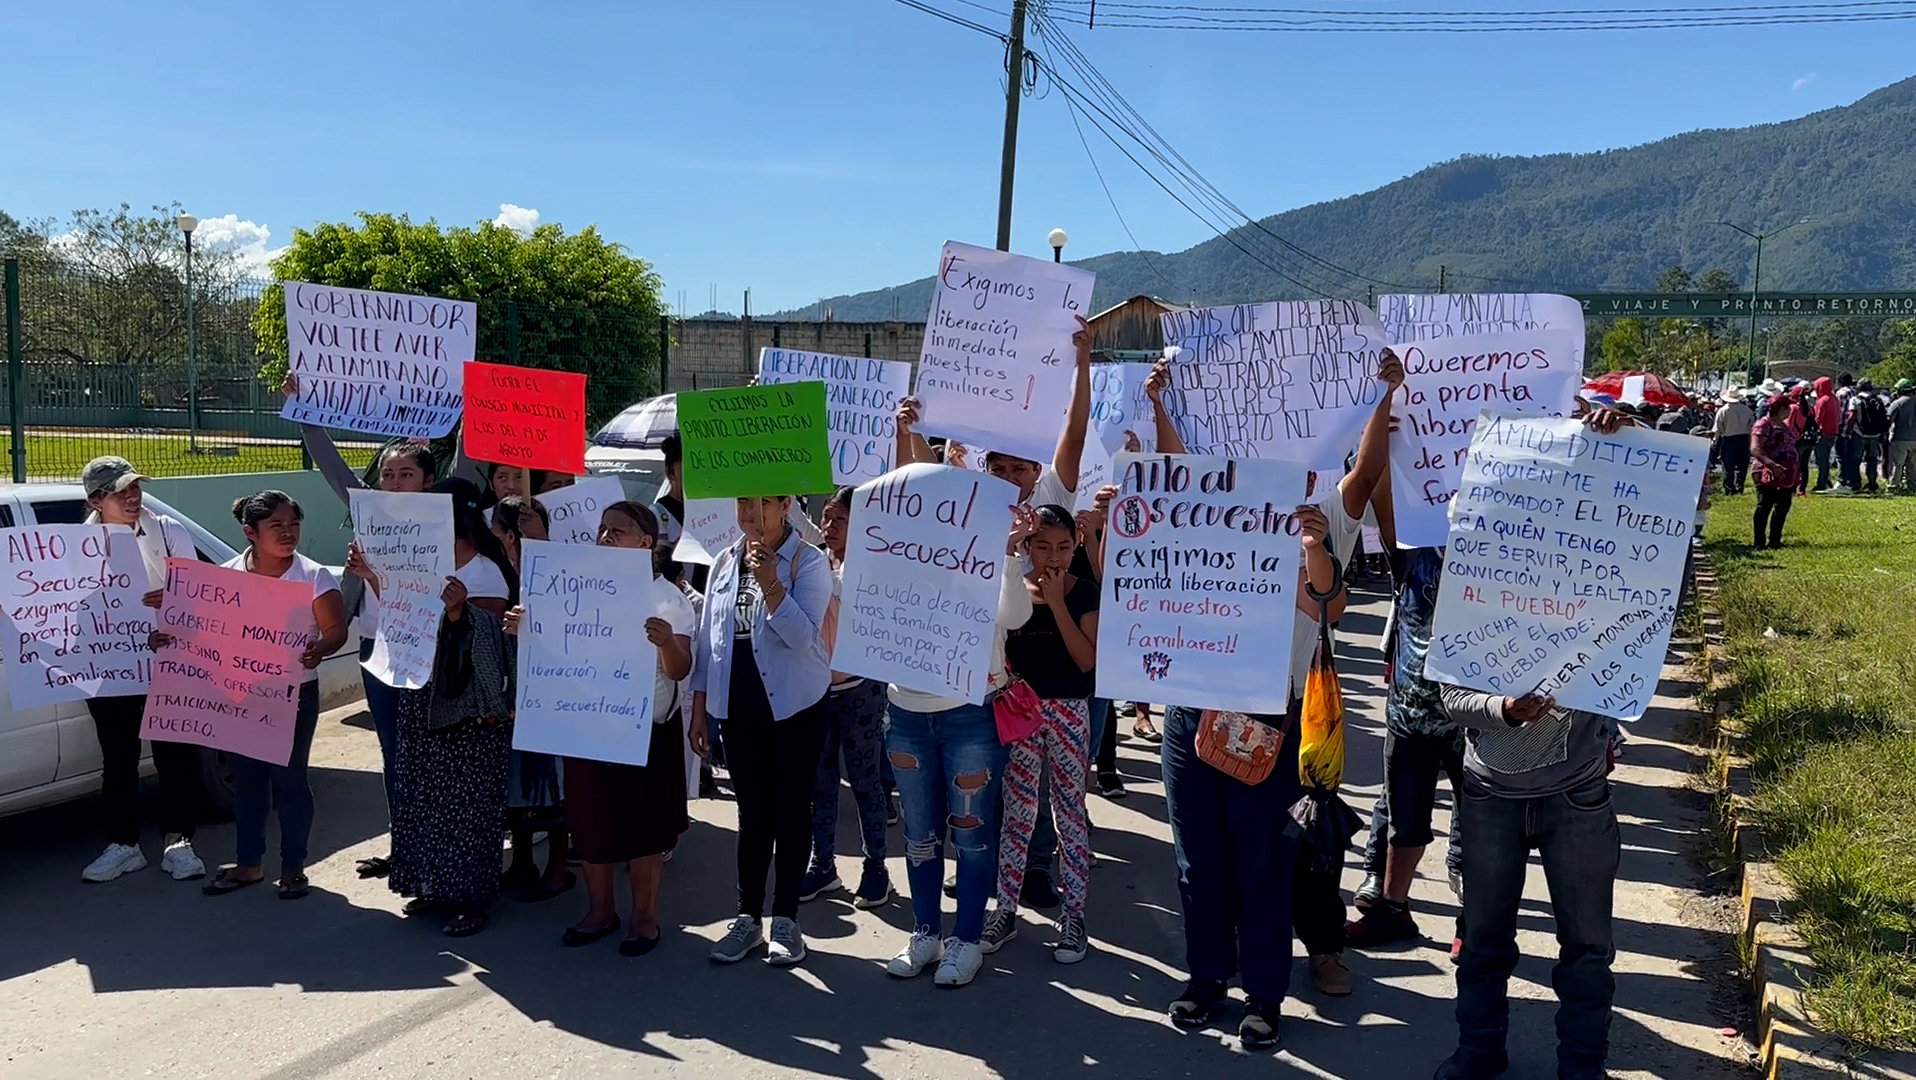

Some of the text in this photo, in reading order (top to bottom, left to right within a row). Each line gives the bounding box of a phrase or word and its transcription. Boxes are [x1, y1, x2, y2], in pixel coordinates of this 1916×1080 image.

[296, 284, 469, 336] GOBERNADOR
[1062, 284, 1079, 310] la
[1612, 298, 1913, 310] VIAJE Y PRONTO RETORNO
[934, 291, 1018, 340] liberación
[1230, 304, 1264, 335] QUE
[932, 331, 1060, 367] inmediata de
[1239, 324, 1368, 363] FAMILIARES
[1404, 347, 1550, 375] Queremos
[295, 350, 448, 389] A ALTAMIRANO
[867, 360, 887, 384] DE
[923, 354, 1007, 380] nuestros
[297, 373, 392, 419] EXIGIMOS
[525, 377, 542, 393] EL
[777, 391, 795, 408] LA
[1403, 383, 1426, 406] la
[1439, 372, 1533, 411] pronta
[292, 408, 312, 420] DE
[320, 415, 344, 426] LOS
[473, 420, 494, 434] LOS
[500, 423, 516, 437] DEL
[536, 428, 549, 441] DE
[573, 410, 580, 421] Y
[827, 410, 895, 438] UEREMOS
[690, 451, 705, 469] DE
[708, 450, 729, 469] LOS
[733, 447, 812, 467] COMPAÑEROS
[1414, 447, 1445, 470] de
[1480, 415, 1555, 454] AMLO
[1568, 433, 1694, 475] DIJISTE:
[1200, 460, 1238, 494] al
[1562, 470, 1596, 493] ME
[1613, 480, 1641, 500] HA
[865, 471, 979, 530] Alto al
[1468, 486, 1565, 518] APOYADO?
[1575, 500, 1603, 522] EL
[1616, 504, 1686, 538] PUEBLO
[9, 526, 112, 563] Alto al
[413, 544, 438, 563] para
[865, 525, 995, 580] Secuestro
[1492, 517, 1545, 542] QUIÉN
[1555, 530, 1616, 556] TENGO
[1115, 541, 1280, 579] exigimos la
[1454, 537, 1626, 586] QUE SERVIR, POR
[12, 560, 132, 597] Secuestro
[856, 573, 879, 596] La
[884, 582, 921, 607] vida
[927, 590, 951, 614] de
[1114, 571, 1282, 602] pronta liberación
[1447, 562, 1672, 610] CONVICCIÓN Y LEALTAD?
[1463, 585, 1486, 604] AL
[11, 592, 123, 627] exigimos la
[853, 593, 980, 647] tras familias no
[1126, 593, 1243, 619] de nuestros
[19, 615, 86, 654] pronta
[164, 606, 308, 648] GABRIEL MONTOYA
[529, 604, 614, 655] la pronta
[1127, 623, 1239, 654] familiares!!
[1439, 616, 1519, 659] ESCUCHA
[1592, 607, 1655, 650] MONTOYA
[55, 638, 82, 657] de
[526, 645, 630, 680] liberación de
[895, 634, 913, 646] un
[915, 638, 942, 656] par
[946, 645, 969, 664] de
[1461, 663, 1482, 679] LO
[1483, 636, 1518, 669] QUE
[1487, 617, 1596, 692] PUEBLO PIDE:
[1591, 604, 1676, 688] LOS QUEREMOS
[224, 677, 295, 703] OPRESOR!
[520, 685, 542, 710] los
[154, 694, 277, 728] TRAICIONASTE AL
